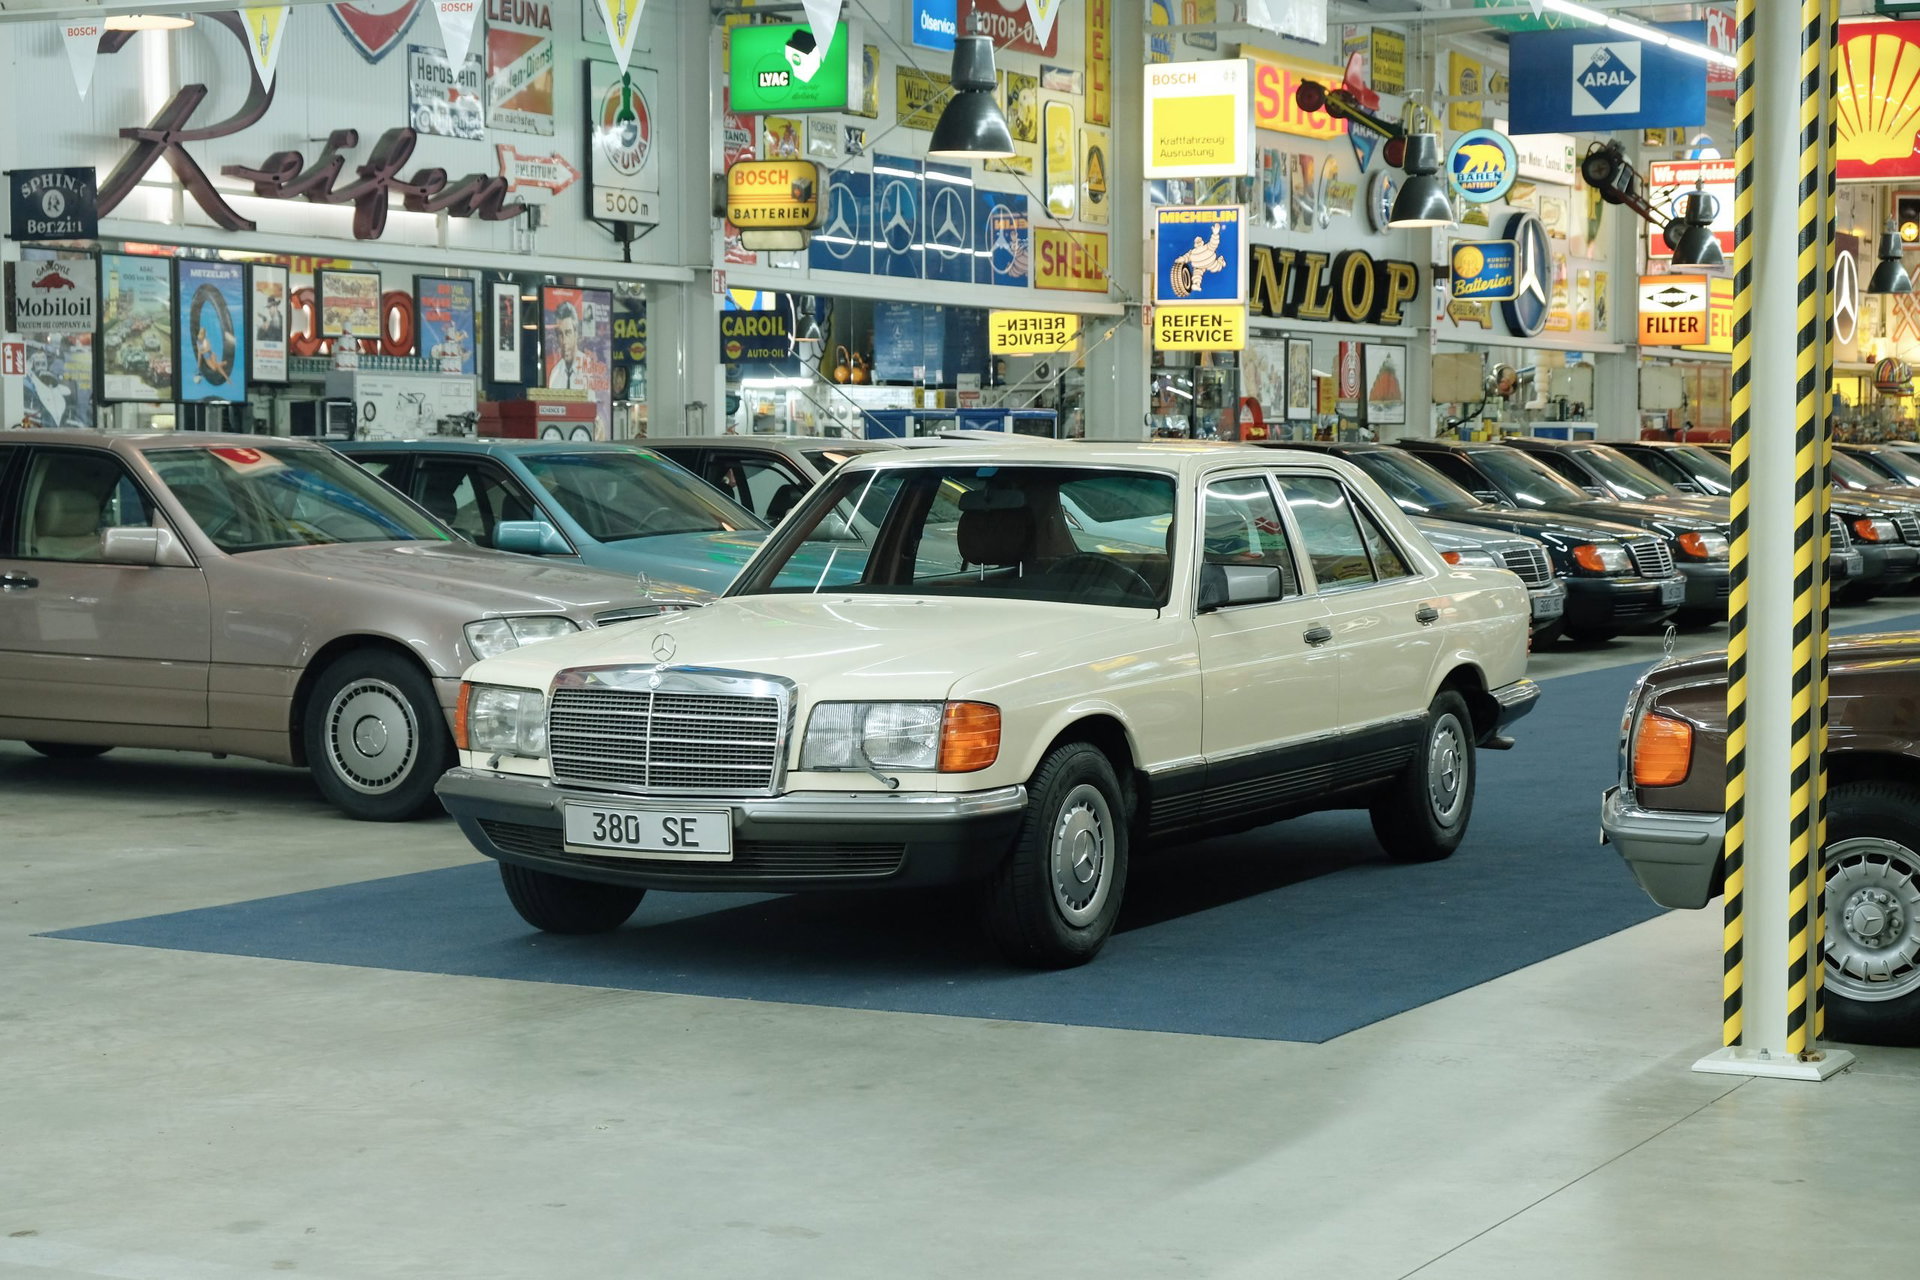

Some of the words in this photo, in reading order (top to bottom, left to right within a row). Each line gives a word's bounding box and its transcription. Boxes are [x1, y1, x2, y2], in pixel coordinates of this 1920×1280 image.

[440, 2, 474, 13] BOSCH
[486, 0, 552, 31] LEUNA
[67, 26, 97, 37] BOSCH
[920, 10, 956, 36] Ölservice
[1092, 0, 1104, 122] HELL
[416, 57, 477, 88] Herbsein
[759, 71, 788, 87] LYAC
[1152, 72, 1197, 85] BOSCH
[1584, 71, 1631, 88] ARAL
[96, 10, 526, 240] Reifen
[724, 129, 749, 143] TANOL
[735, 169, 789, 186] BOSCH
[1653, 165, 1675, 183] Wir
[605, 192, 639, 215] 500
[640, 203, 649, 217] m
[734, 207, 810, 220] BATTERIEN
[1160, 209, 1237, 223] MICHELIN
[1041, 239, 1104, 281] SHELL
[190, 268, 230, 280] METZELER
[1250, 243, 1419, 326] NLOP
[1453, 274, 1513, 297] Batterien
[16, 297, 91, 317] Mobiloil
[721, 315, 786, 337] CAROIL
[1646, 316, 1699, 333] FILTER
[1161, 328, 1234, 343] SERVICE
[747, 348, 785, 358] AUTO-OIL
[592, 811, 640, 845] 380
[662, 816, 700, 848] SE
